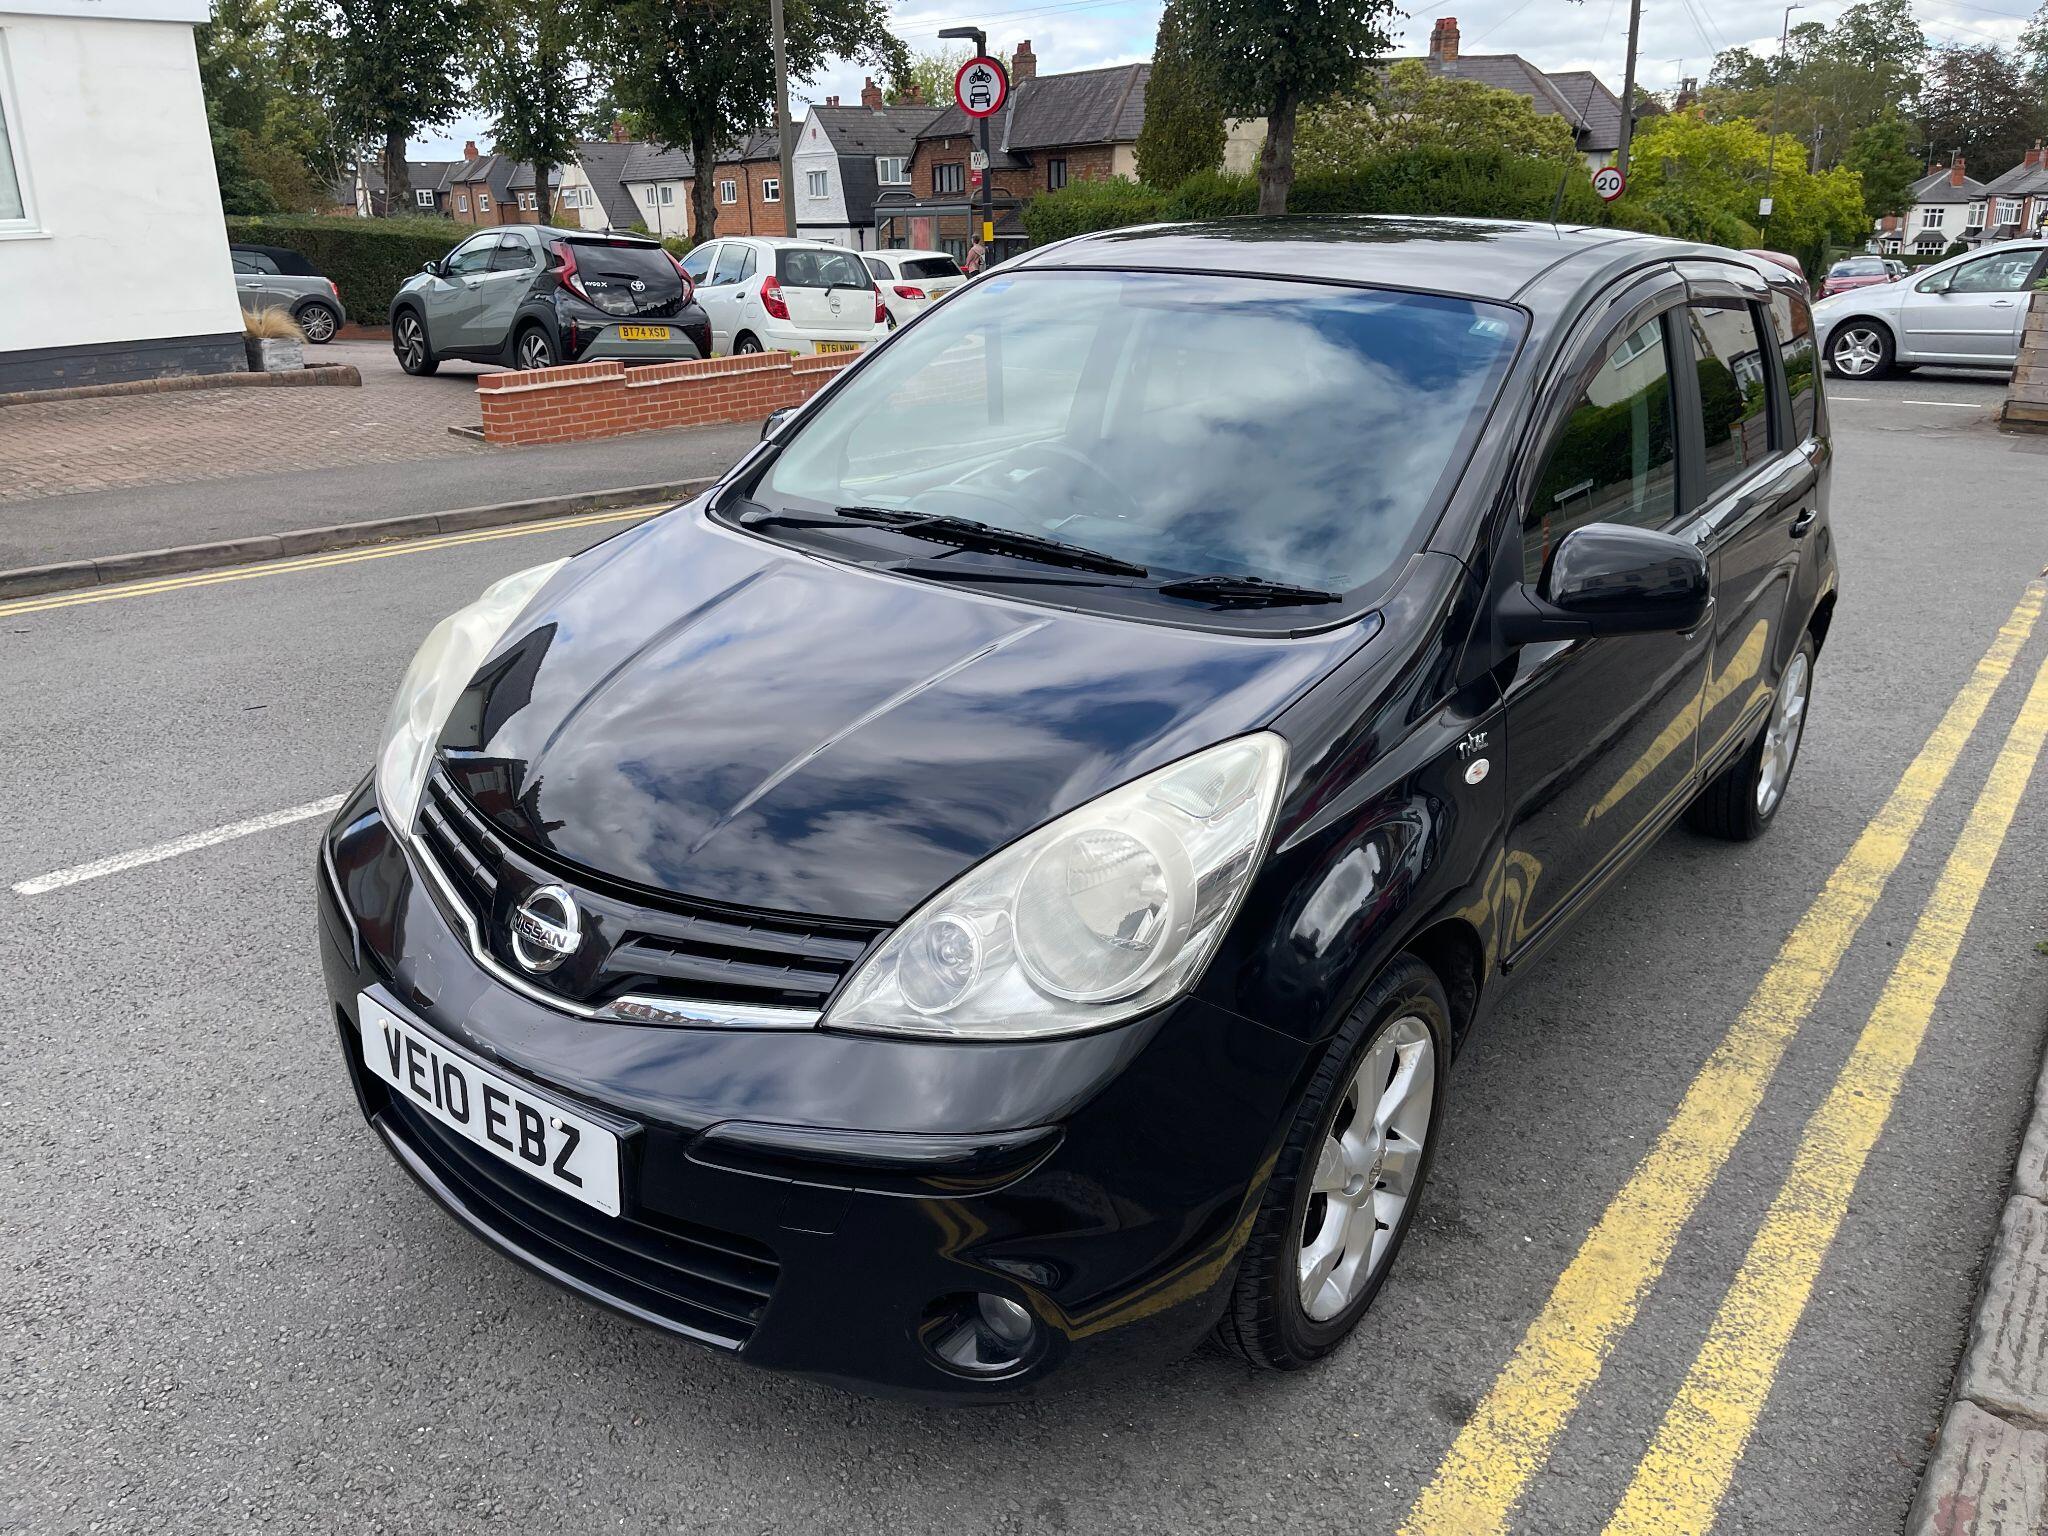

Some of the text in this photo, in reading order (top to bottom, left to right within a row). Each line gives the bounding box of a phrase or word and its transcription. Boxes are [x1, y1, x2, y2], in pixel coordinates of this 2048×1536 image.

[1597, 177, 1620, 191] 20
[623, 326, 666, 337] BT74 XSD
[821, 344, 839, 353] BT61
[514, 911, 567, 949] NISSAN
[385, 1029, 583, 1189] VE10 EBZ
